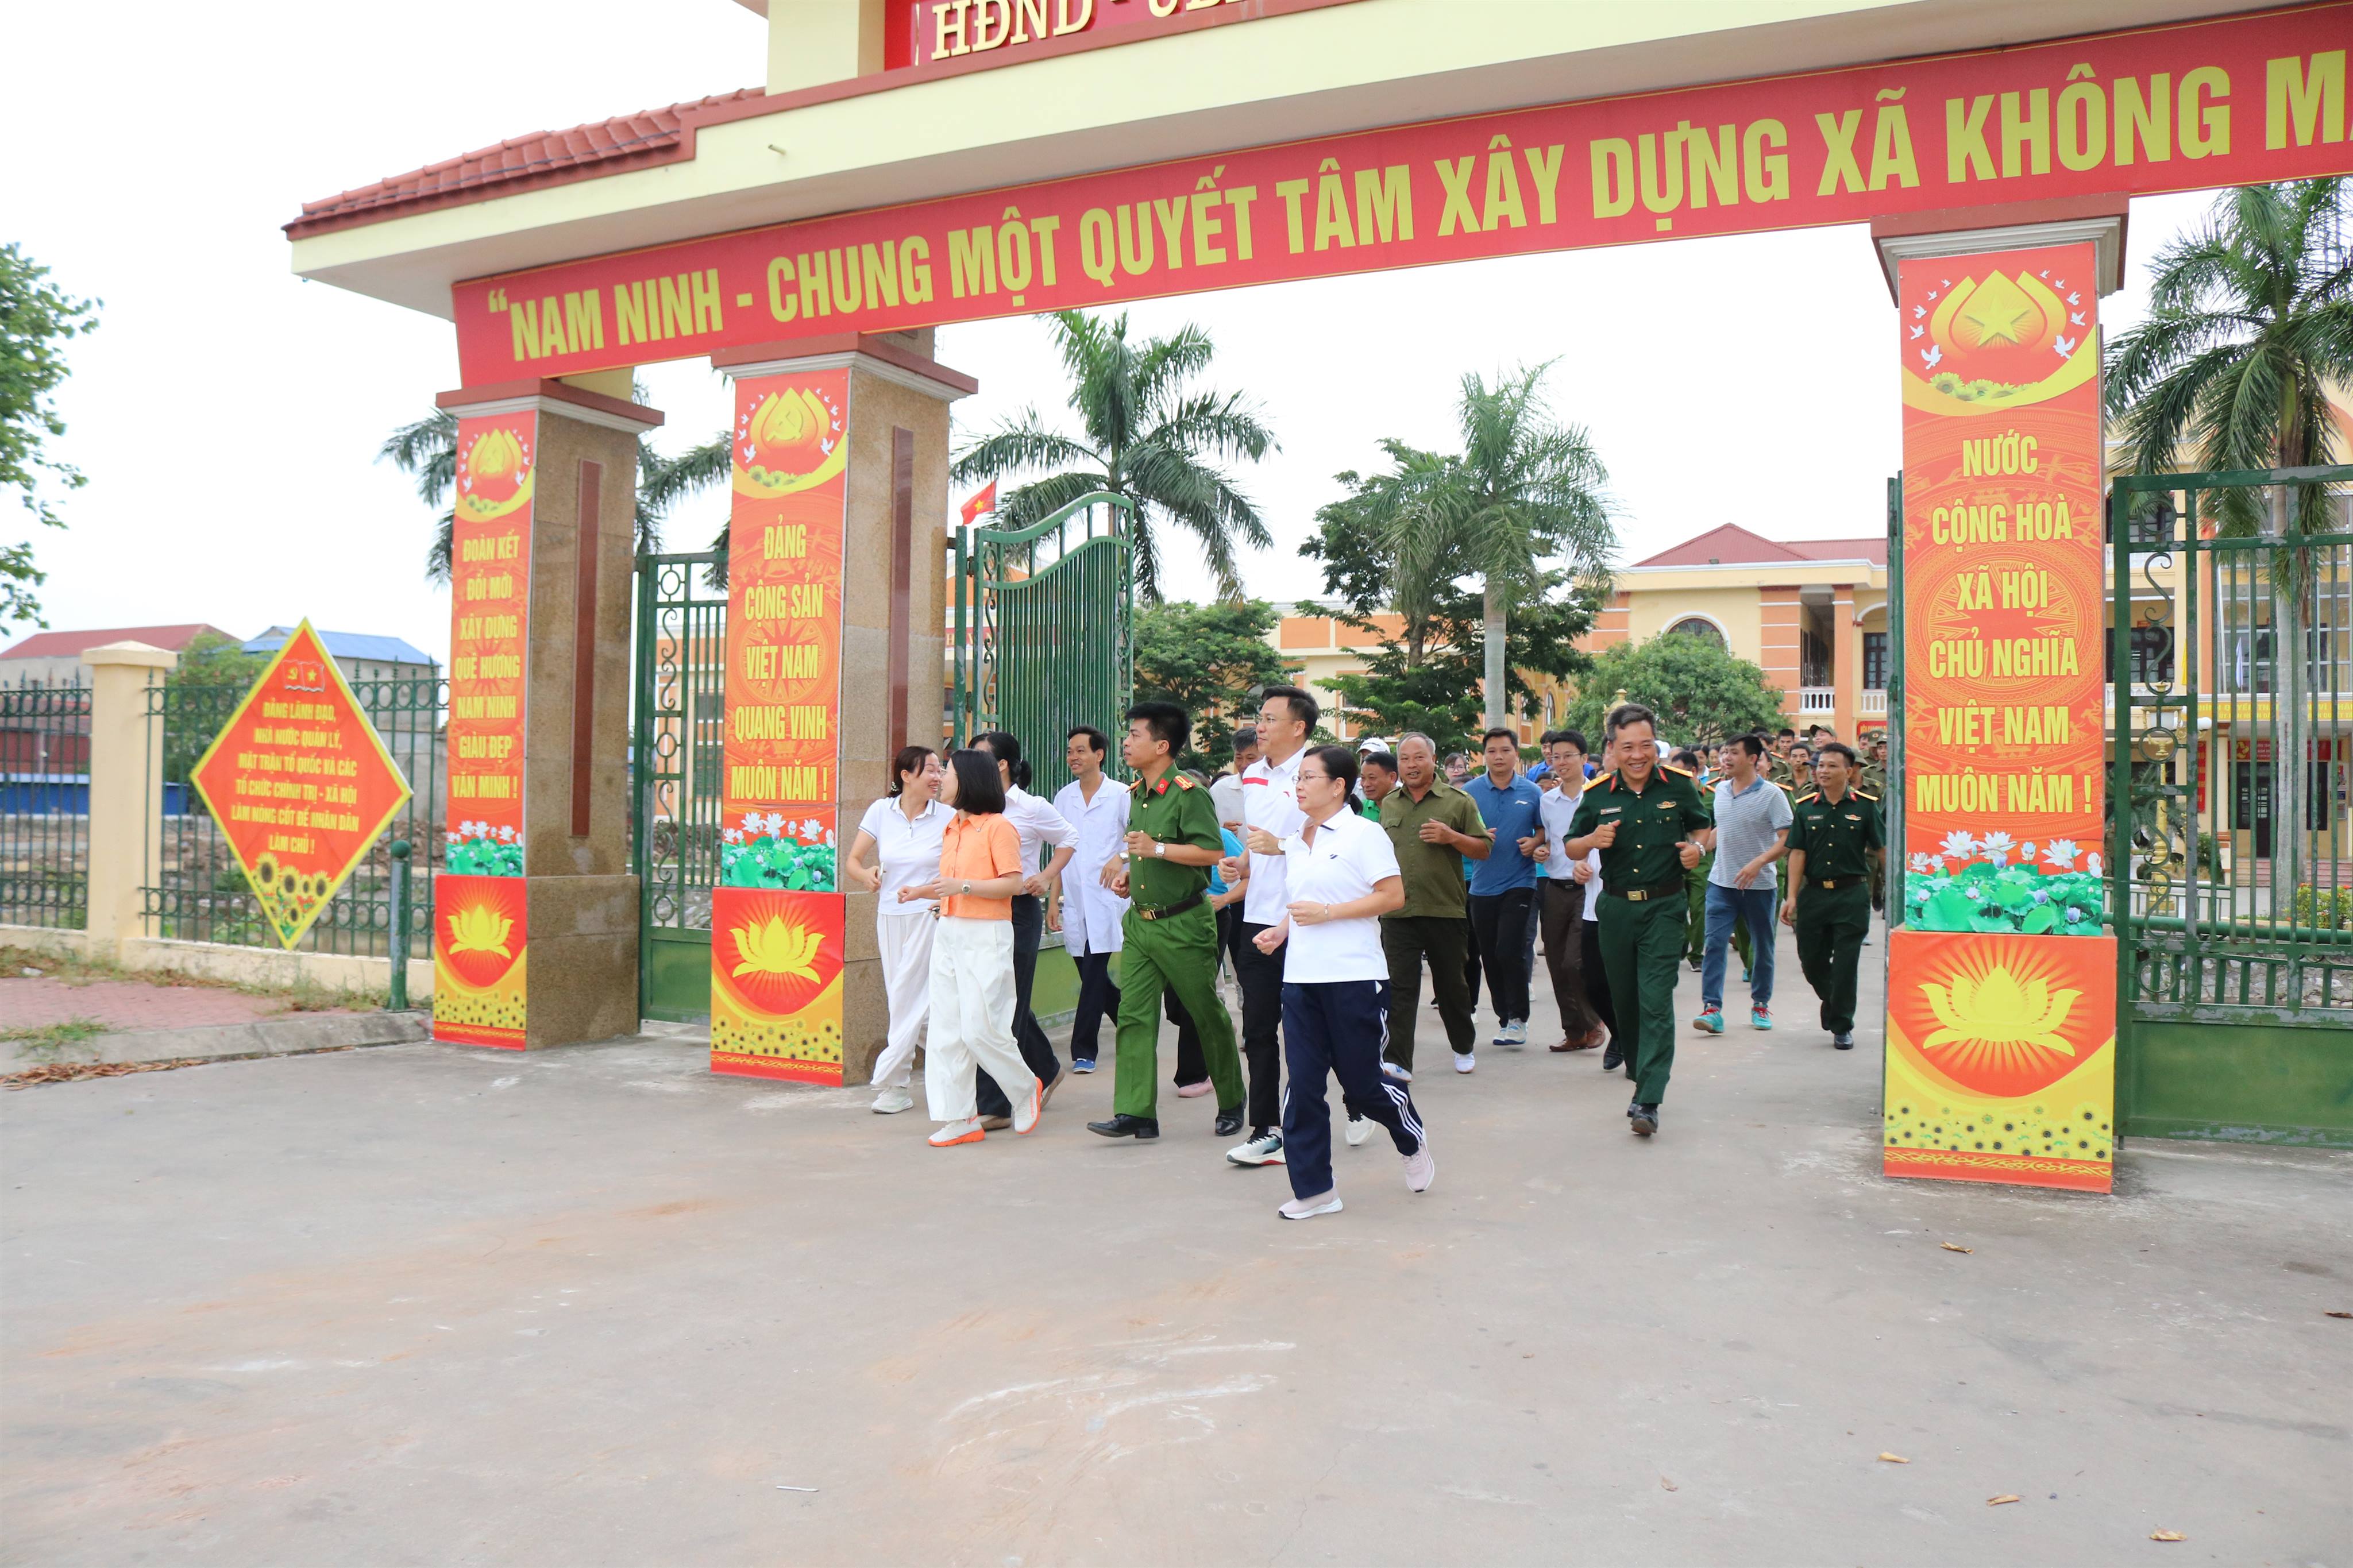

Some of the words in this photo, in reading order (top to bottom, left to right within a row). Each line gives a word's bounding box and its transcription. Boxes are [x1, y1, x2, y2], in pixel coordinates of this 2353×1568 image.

[614, 269, 723, 346] NINH
[736, 293, 753, 308] -
[767, 236, 933, 322] CHUNG
[948, 206, 1059, 307] MỘT
[1080, 165, 1257, 287] QUYẾT
[1276, 157, 1414, 254] TÂM
[1434, 134, 1564, 237] XÂY
[1590, 119, 1789, 231] DỰNG
[1815, 86, 1920, 196] XÃ
[1946, 63, 2230, 183] KHÔNG
[2266, 49, 2353, 150] M
[1962, 429, 2038, 477] NƯỚC
[764, 514, 807, 560] ĐẢNG
[1932, 499, 2007, 553] CỘNG
[2016, 494, 2072, 541] HOÀ
[462, 534, 495, 562] ĐOÀN
[497, 528, 520, 559] KẾT
[466, 569, 487, 600] ĐỔI
[489, 571, 513, 599] MỚI
[745, 580, 786, 627] CỘNG
[791, 572, 823, 619] SẢN
[1957, 565, 1993, 611] XÃ
[2003, 562, 2047, 617] HỘI
[460, 613, 482, 640] XÂY
[485, 614, 518, 643] DỰNG
[454, 652, 477, 681] QUÊ
[480, 655, 520, 679] HƯƠNG
[746, 639, 778, 687] VIỆT
[782, 644, 819, 679] NAM
[1929, 626, 1984, 679] CHỦ
[1993, 629, 2079, 677] NGHĨA
[263, 697, 288, 718] ĐẢNG
[290, 701, 314, 720] LÃNH
[457, 696, 484, 719] NAM
[486, 696, 516, 719] NINH
[735, 706, 785, 743] QUANG
[790, 706, 827, 740] VINH
[254, 725, 273, 744] NHÀ
[275, 727, 299, 746] NƯỚC
[1938, 698, 1995, 753] VIỆT
[2004, 706, 2069, 745] NAM
[259, 752, 281, 774] TRẬN
[297, 753, 322, 774] QUỐC
[323, 756, 335, 775] VÀ
[337, 757, 357, 776] CÁC
[460, 731, 487, 759] GIÀU
[489, 735, 512, 763] ĐẸP
[273, 779, 301, 800] CHÍNH
[303, 785, 317, 804] TRỊ
[325, 783, 338, 802] XÃ
[340, 785, 357, 808] HỘI
[452, 771, 476, 798] VĂN
[479, 775, 510, 798] MINH
[731, 759, 777, 800] MUÔN
[781, 759, 817, 801] NĂM
[823, 767, 828, 801] !
[1916, 767, 2000, 813] MUÔN
[2009, 766, 2072, 813] NĂM
[2084, 775, 2092, 813] !
[231, 802, 250, 821] LÀM
[252, 804, 276, 824] NÒNG
[278, 805, 295, 825] CỐT
[311, 810, 337, 829] NHÂN
[338, 812, 359, 832] DÂN
[269, 832, 288, 851] LÀM
[290, 833, 308, 853] CHỦ
